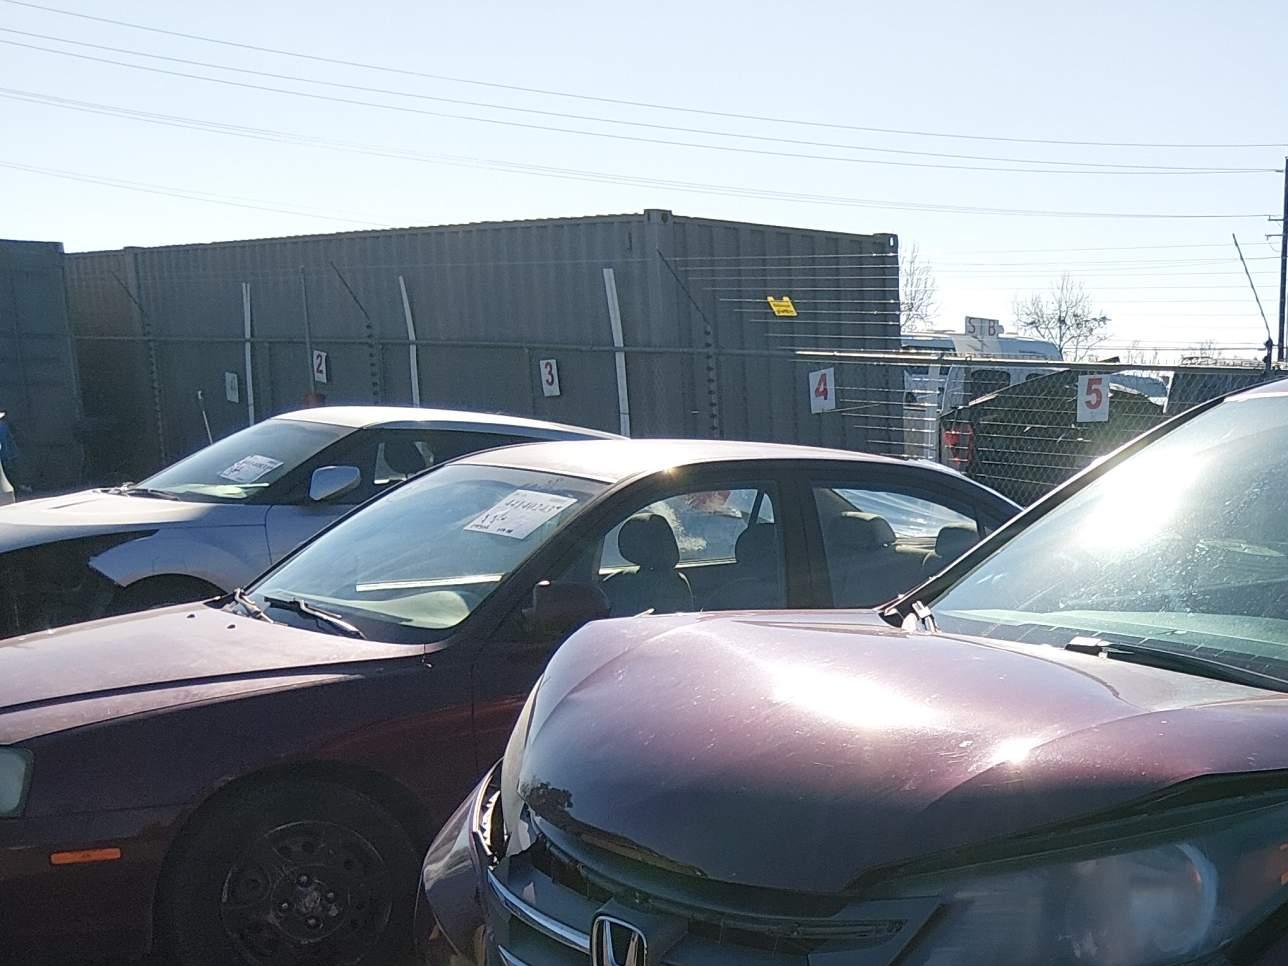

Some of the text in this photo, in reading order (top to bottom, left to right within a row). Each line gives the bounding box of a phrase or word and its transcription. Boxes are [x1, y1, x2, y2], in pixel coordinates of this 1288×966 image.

[315, 353, 324, 375] 2
[544, 361, 555, 386] 3
[815, 372, 829, 401] 4
[1084, 377, 1103, 410] 5
